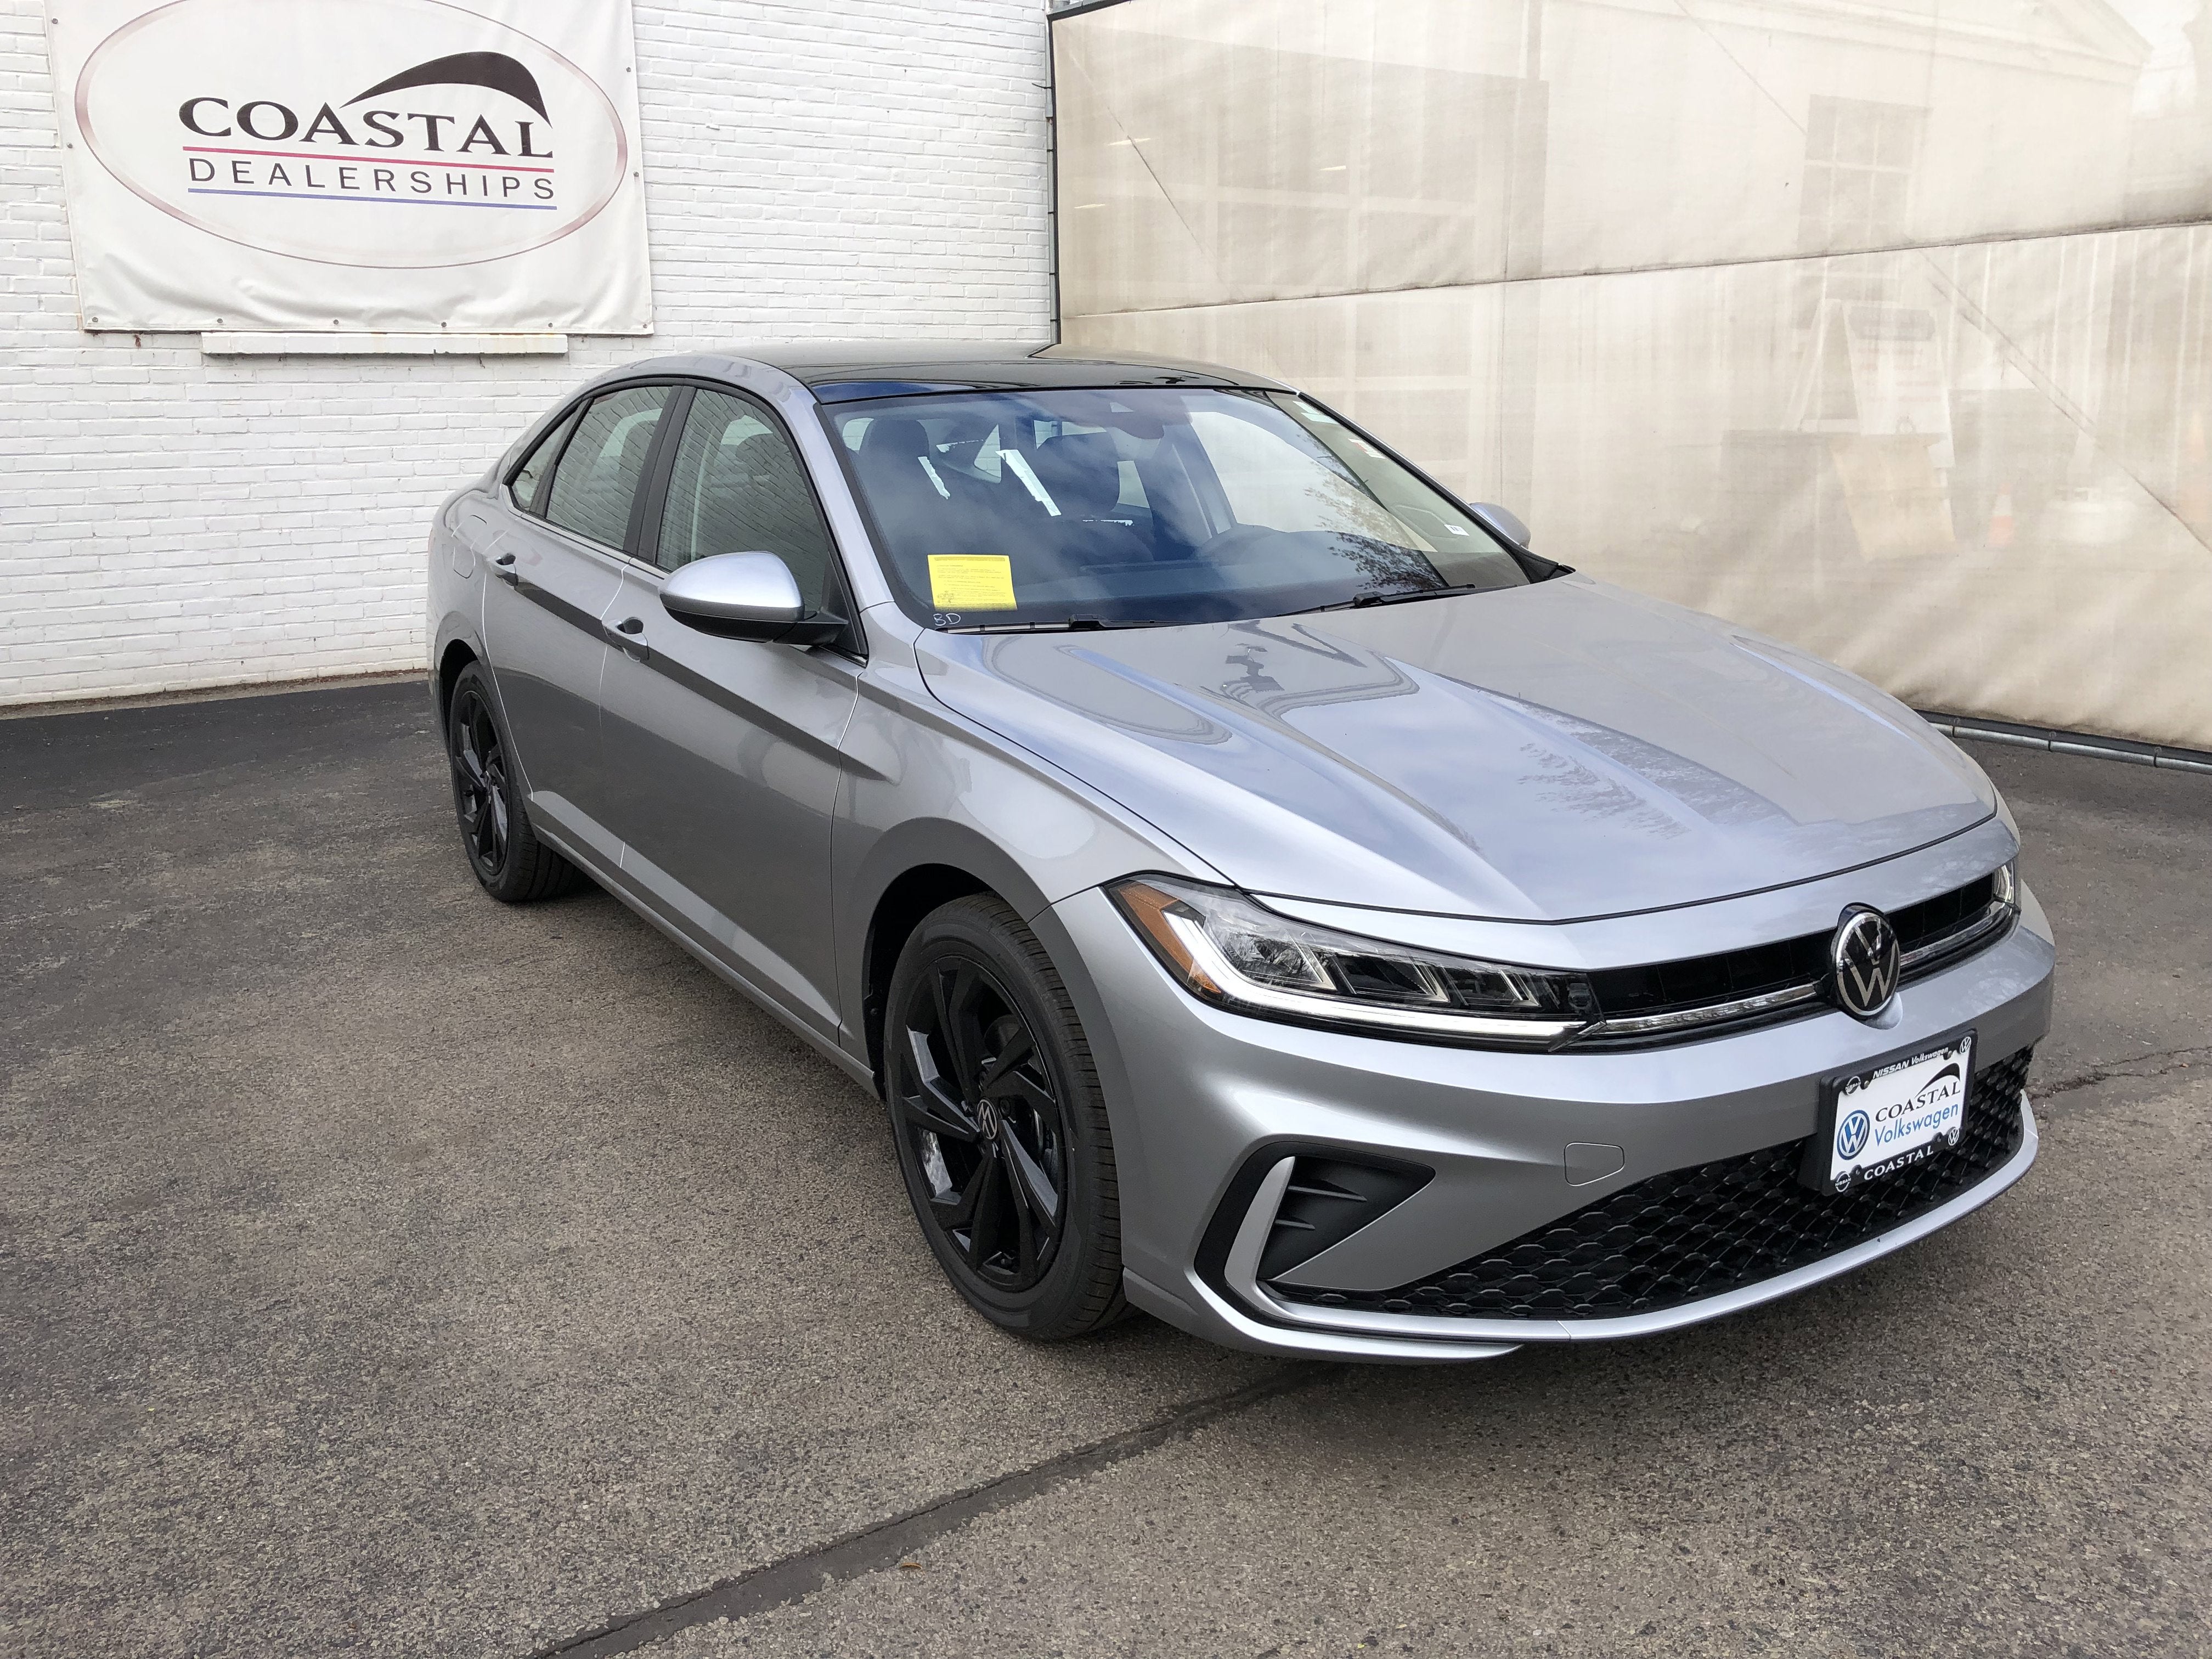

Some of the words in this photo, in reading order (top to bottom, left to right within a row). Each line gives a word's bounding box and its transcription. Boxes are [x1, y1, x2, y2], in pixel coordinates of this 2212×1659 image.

[178, 97, 553, 159] COASTAL
[189, 158, 555, 200] DEALERSHIPS
[1872, 1059, 1909, 1080] NISSAN
[1911, 1047, 1949, 1065] Volkswagen
[1875, 1081, 1961, 1122] COASTAL
[1875, 1104, 1959, 1147] Volkswagen
[1864, 1145, 1934, 1181] COASTAL
